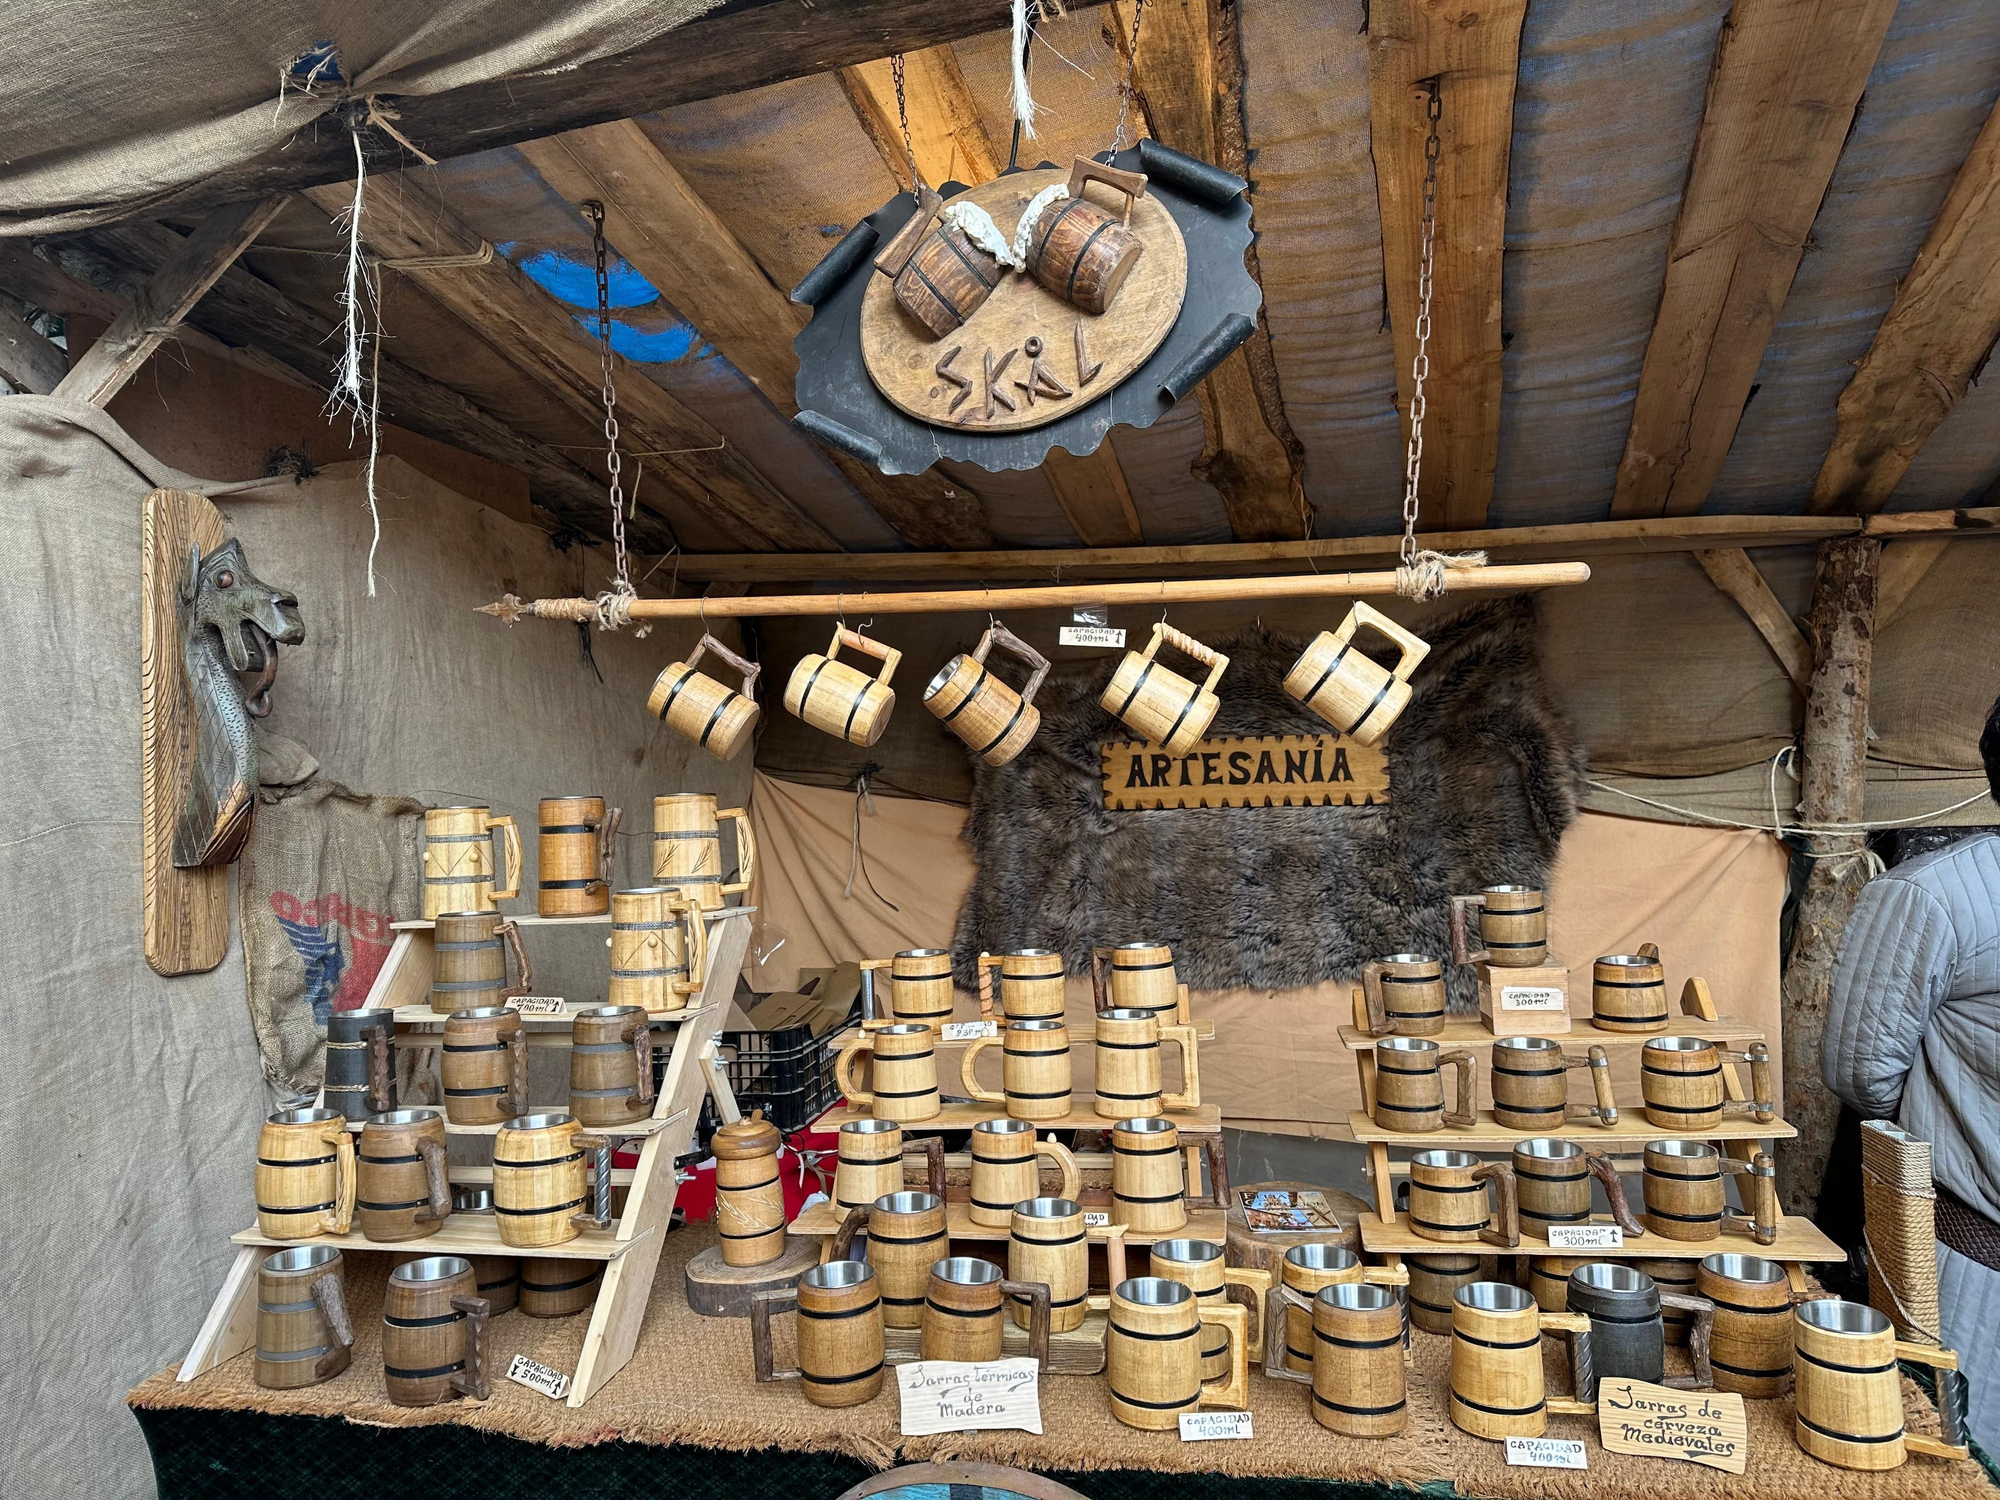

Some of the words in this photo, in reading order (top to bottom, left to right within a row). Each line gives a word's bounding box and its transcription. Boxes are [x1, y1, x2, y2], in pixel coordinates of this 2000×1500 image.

[935, 317, 1104, 420] SKÅL
[1125, 740, 1354, 788] ARTESANÍA
[517, 1357, 564, 1380] CAPACIDAD
[521, 1369, 555, 1388] 500ml
[963, 1387, 983, 1403] de
[1607, 1385, 1687, 1420] Jarras
[1698, 1399, 1722, 1419] de
[936, 1401, 1005, 1417] Madera
[1187, 1414, 1250, 1425] CAPACIDAD
[1643, 1418, 1722, 1436] cerveza
[1510, 1440, 1582, 1454] CAPACIDAD
[1621, 1423, 1735, 1458] Medievales
